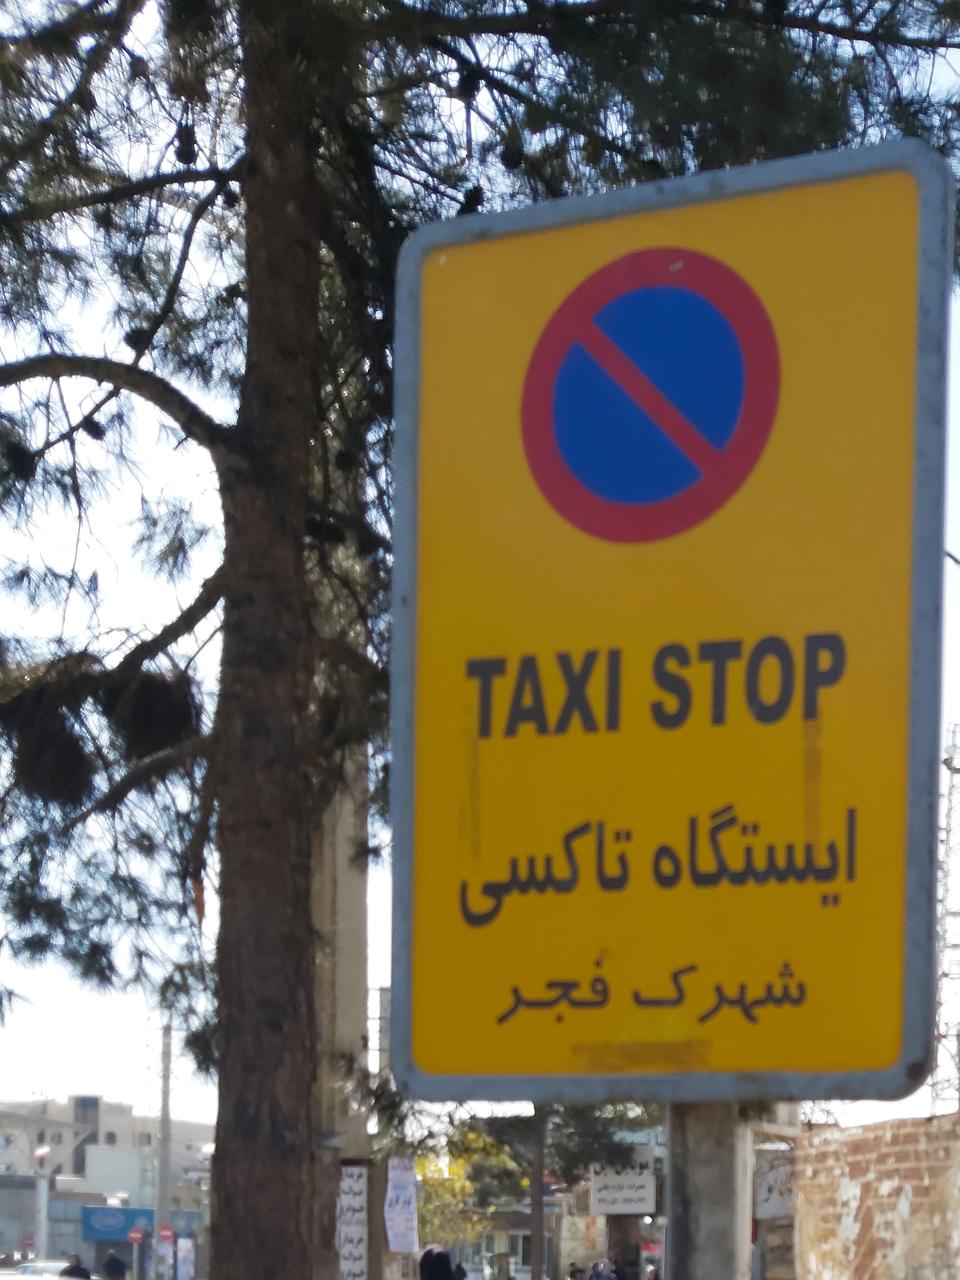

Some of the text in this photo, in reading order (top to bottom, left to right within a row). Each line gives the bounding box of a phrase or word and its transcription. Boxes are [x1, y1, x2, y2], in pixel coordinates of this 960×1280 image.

[465, 633, 847, 740] TAXI STOP
[459, 804, 856, 928] ایستگاه تاکسی
[497, 959, 807, 1025] شهرک فجر
